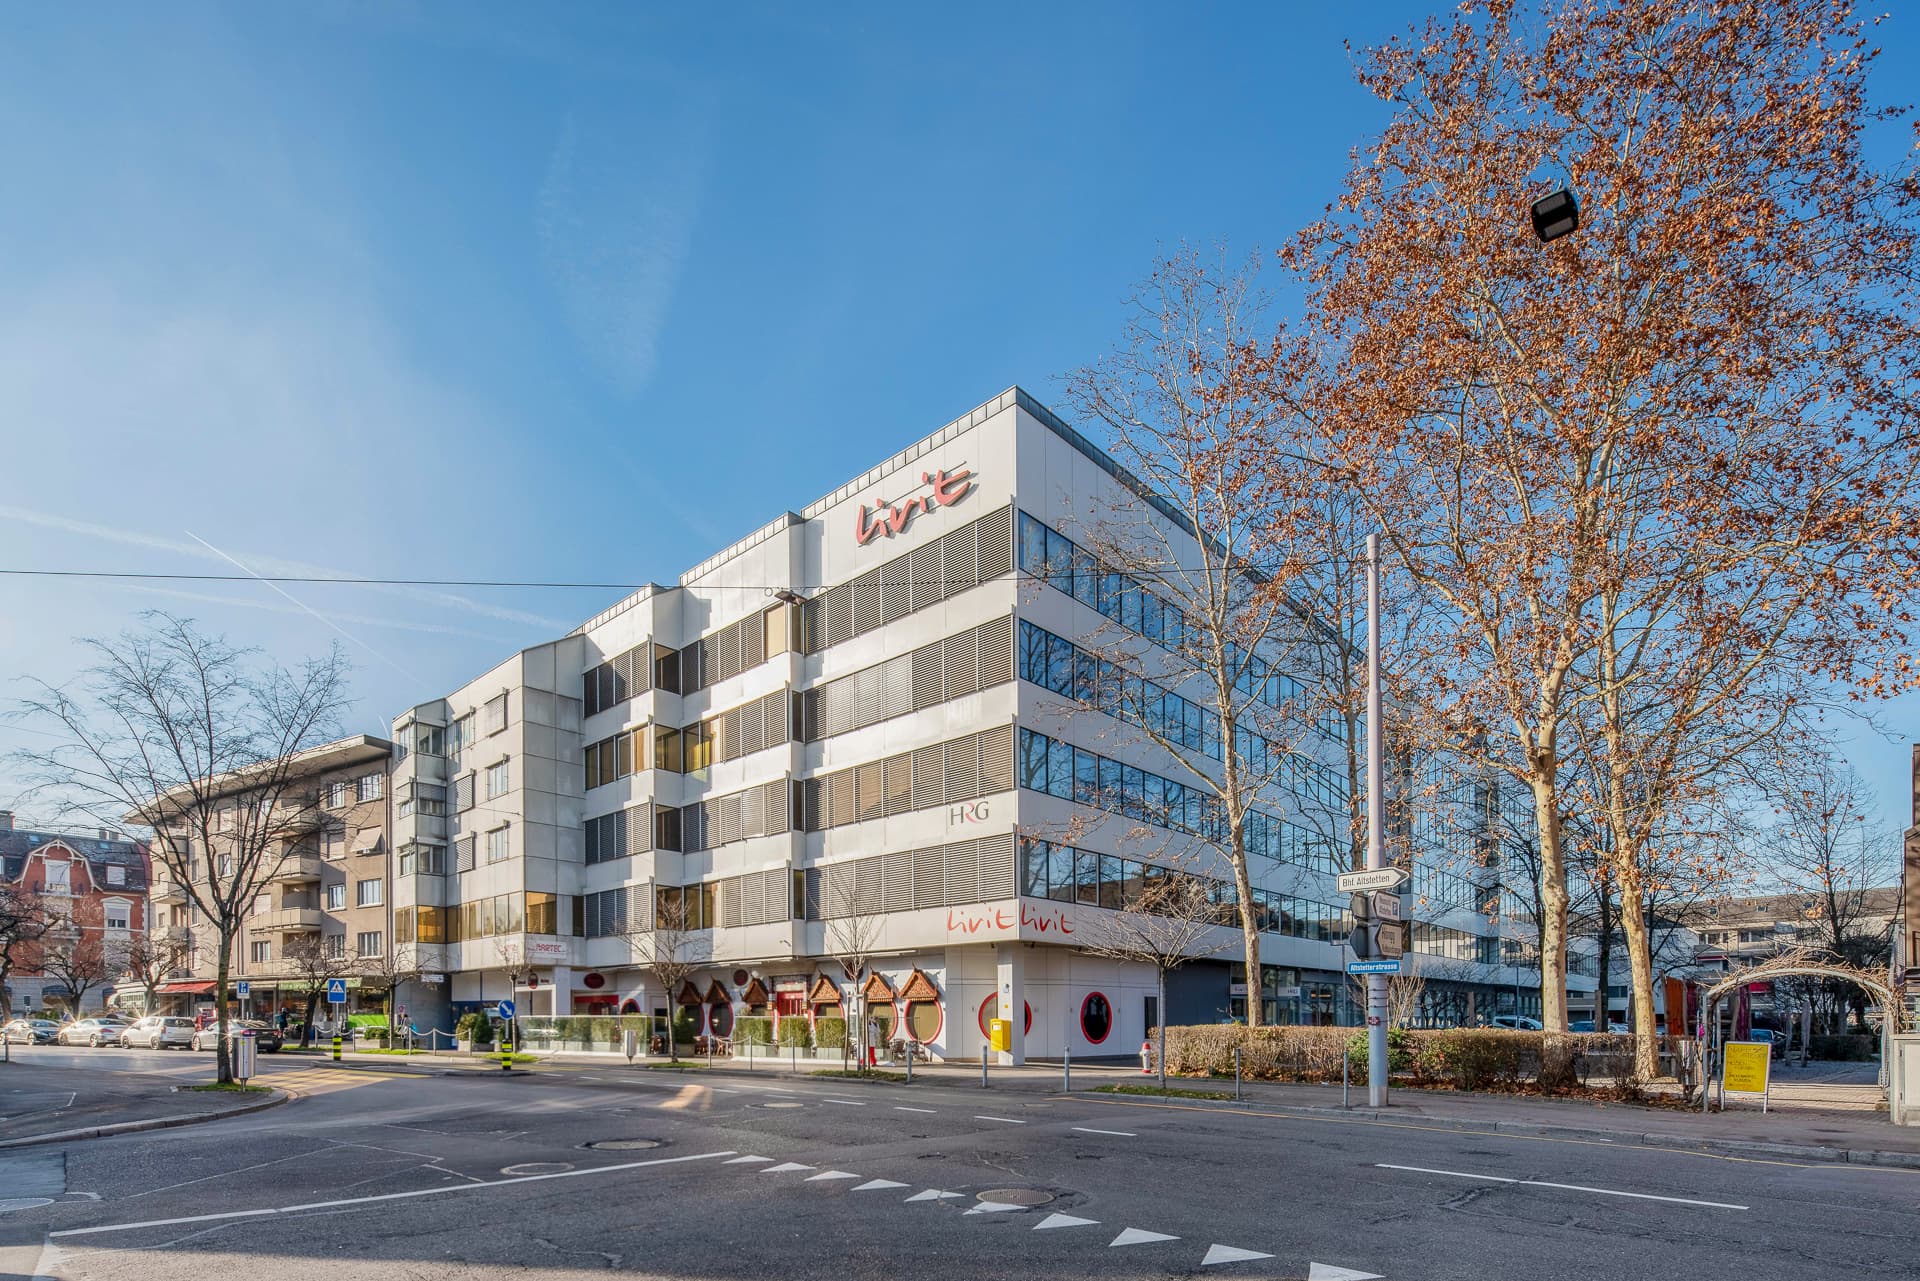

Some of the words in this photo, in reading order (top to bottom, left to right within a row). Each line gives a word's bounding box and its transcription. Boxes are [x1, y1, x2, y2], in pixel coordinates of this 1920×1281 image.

[950, 801, 989, 826] HRG
[1342, 878, 1355, 887] Bhf.
[1357, 875, 1390, 885] Altstetten
[1350, 963, 1398, 972] Altstetterstrasse
